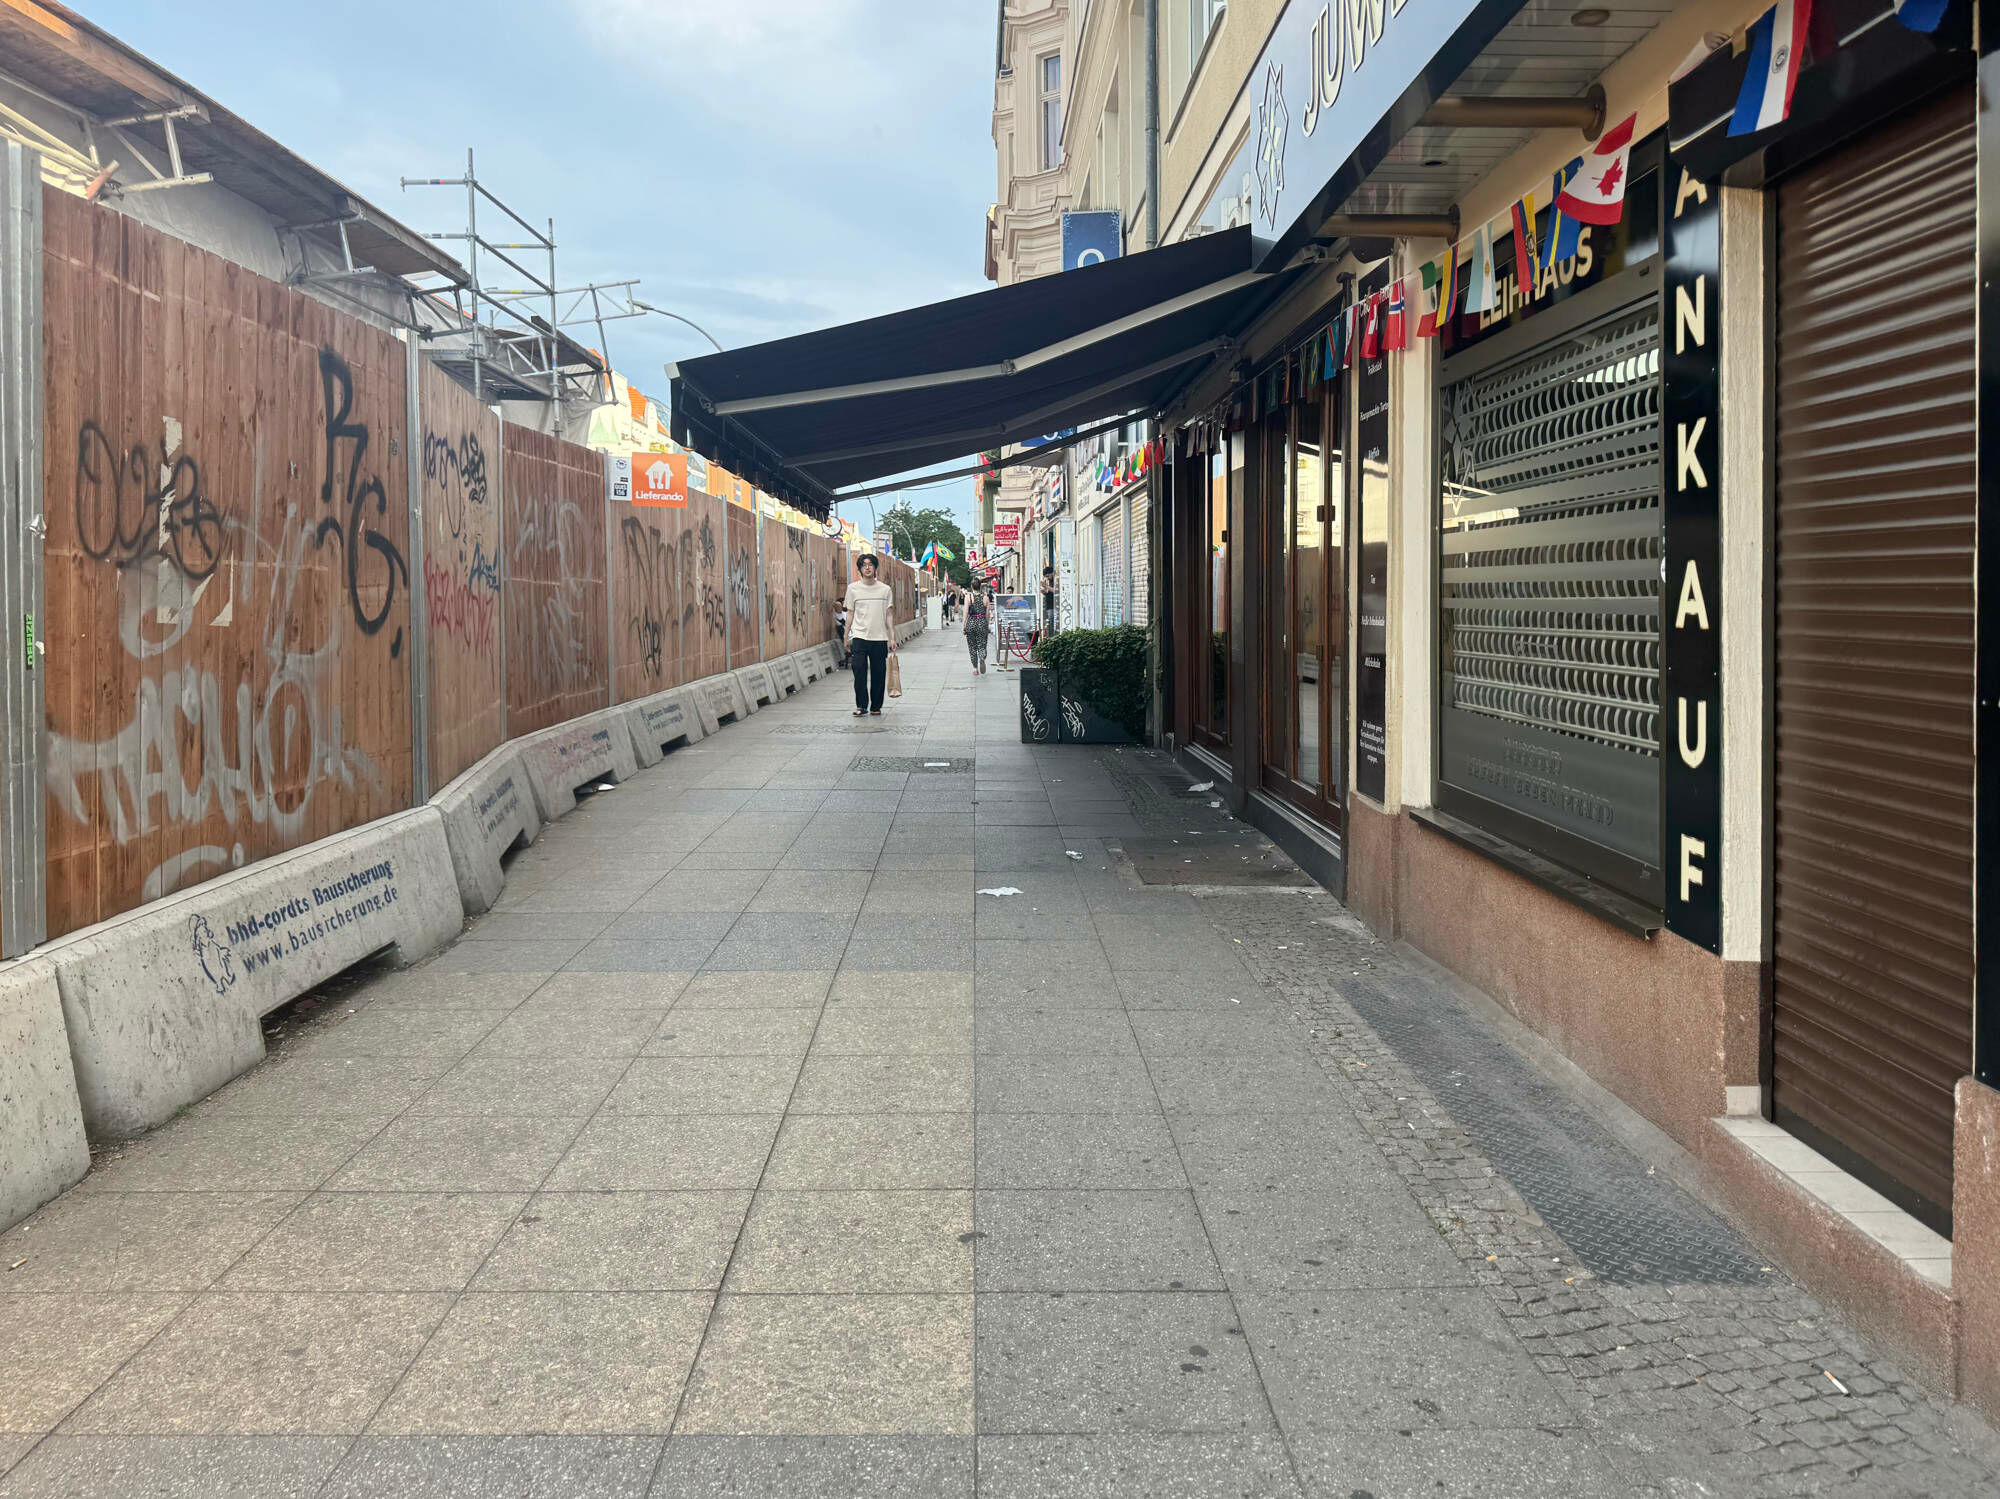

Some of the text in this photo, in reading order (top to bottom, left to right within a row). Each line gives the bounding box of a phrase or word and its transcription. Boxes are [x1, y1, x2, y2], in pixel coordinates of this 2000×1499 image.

[1302, 0, 1408, 137] JUW
[635, 490, 684, 501] Lieferando
[226, 860, 394, 945] bhd-cordts Bausicherung
[242, 884, 399, 974] www.bausicherung.de
